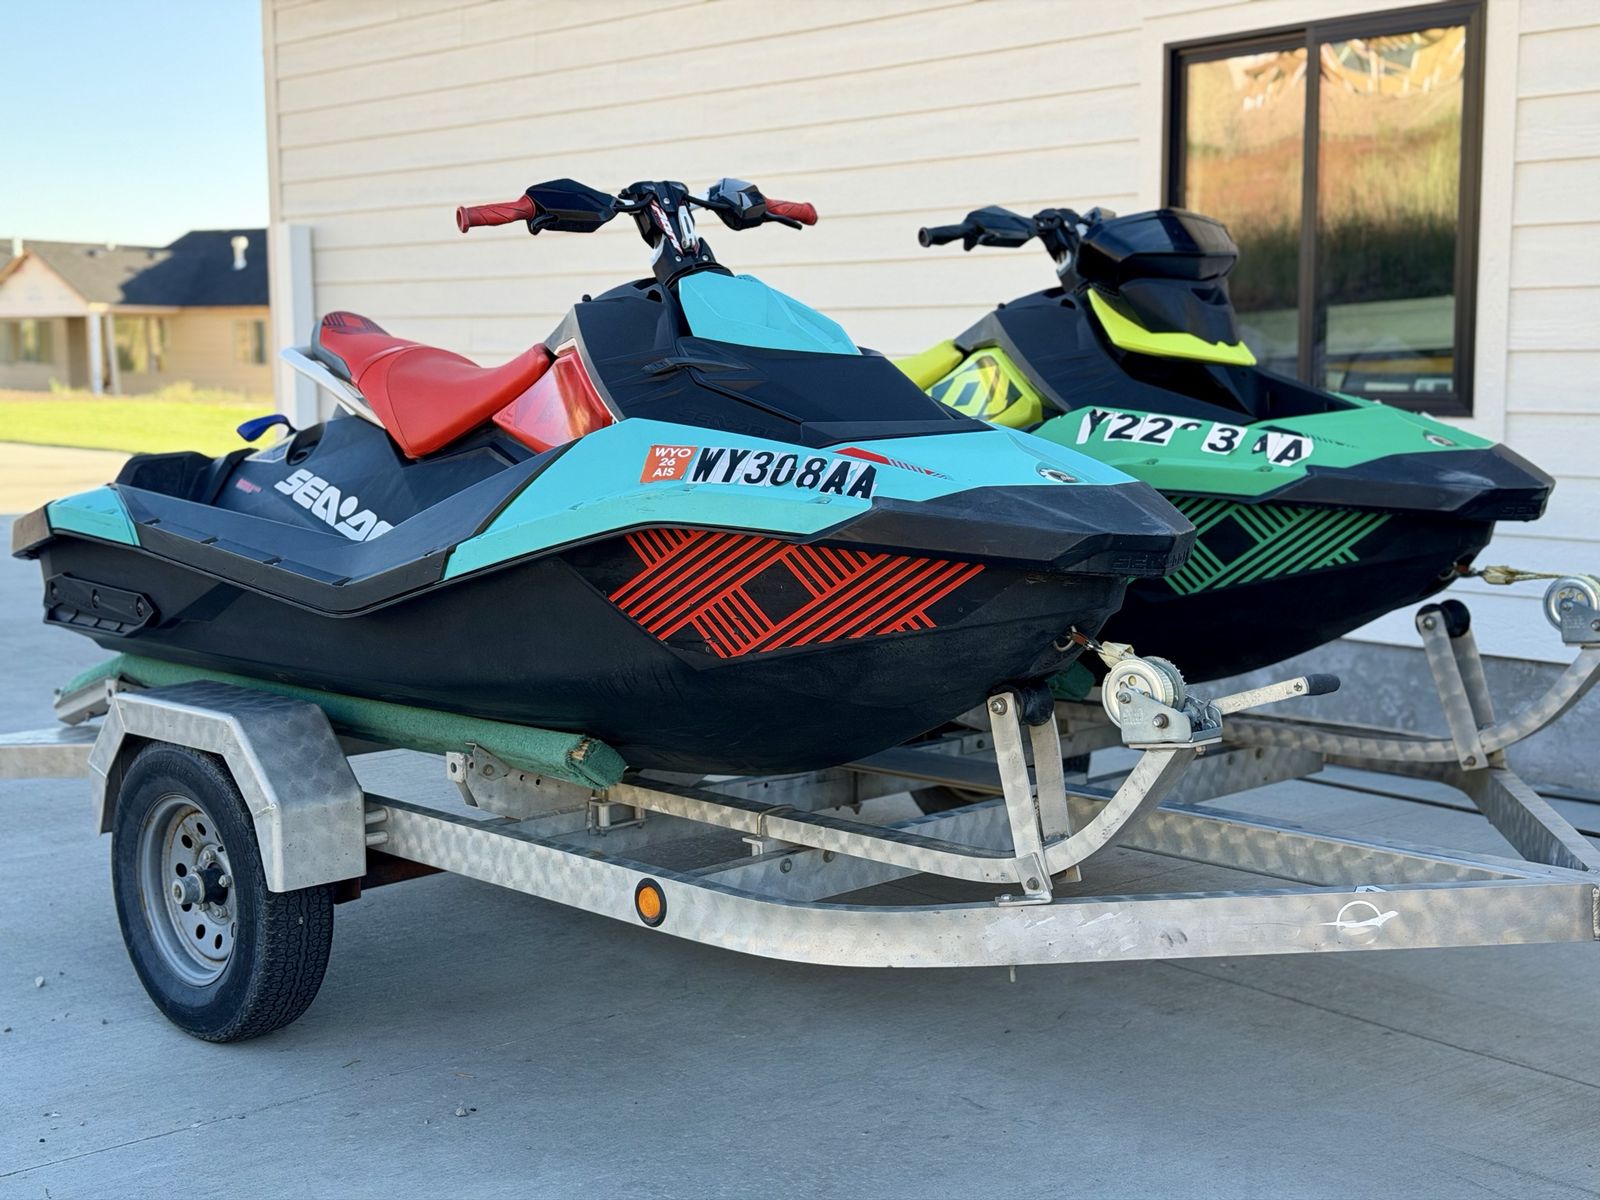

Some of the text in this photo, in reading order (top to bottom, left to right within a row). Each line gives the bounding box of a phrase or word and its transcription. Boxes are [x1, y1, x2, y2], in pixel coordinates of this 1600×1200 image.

[655, 447, 692, 458] WYO
[658, 457, 677, 467] 26
[652, 467, 676, 478] AIS
[692, 447, 877, 499] WY308AA
